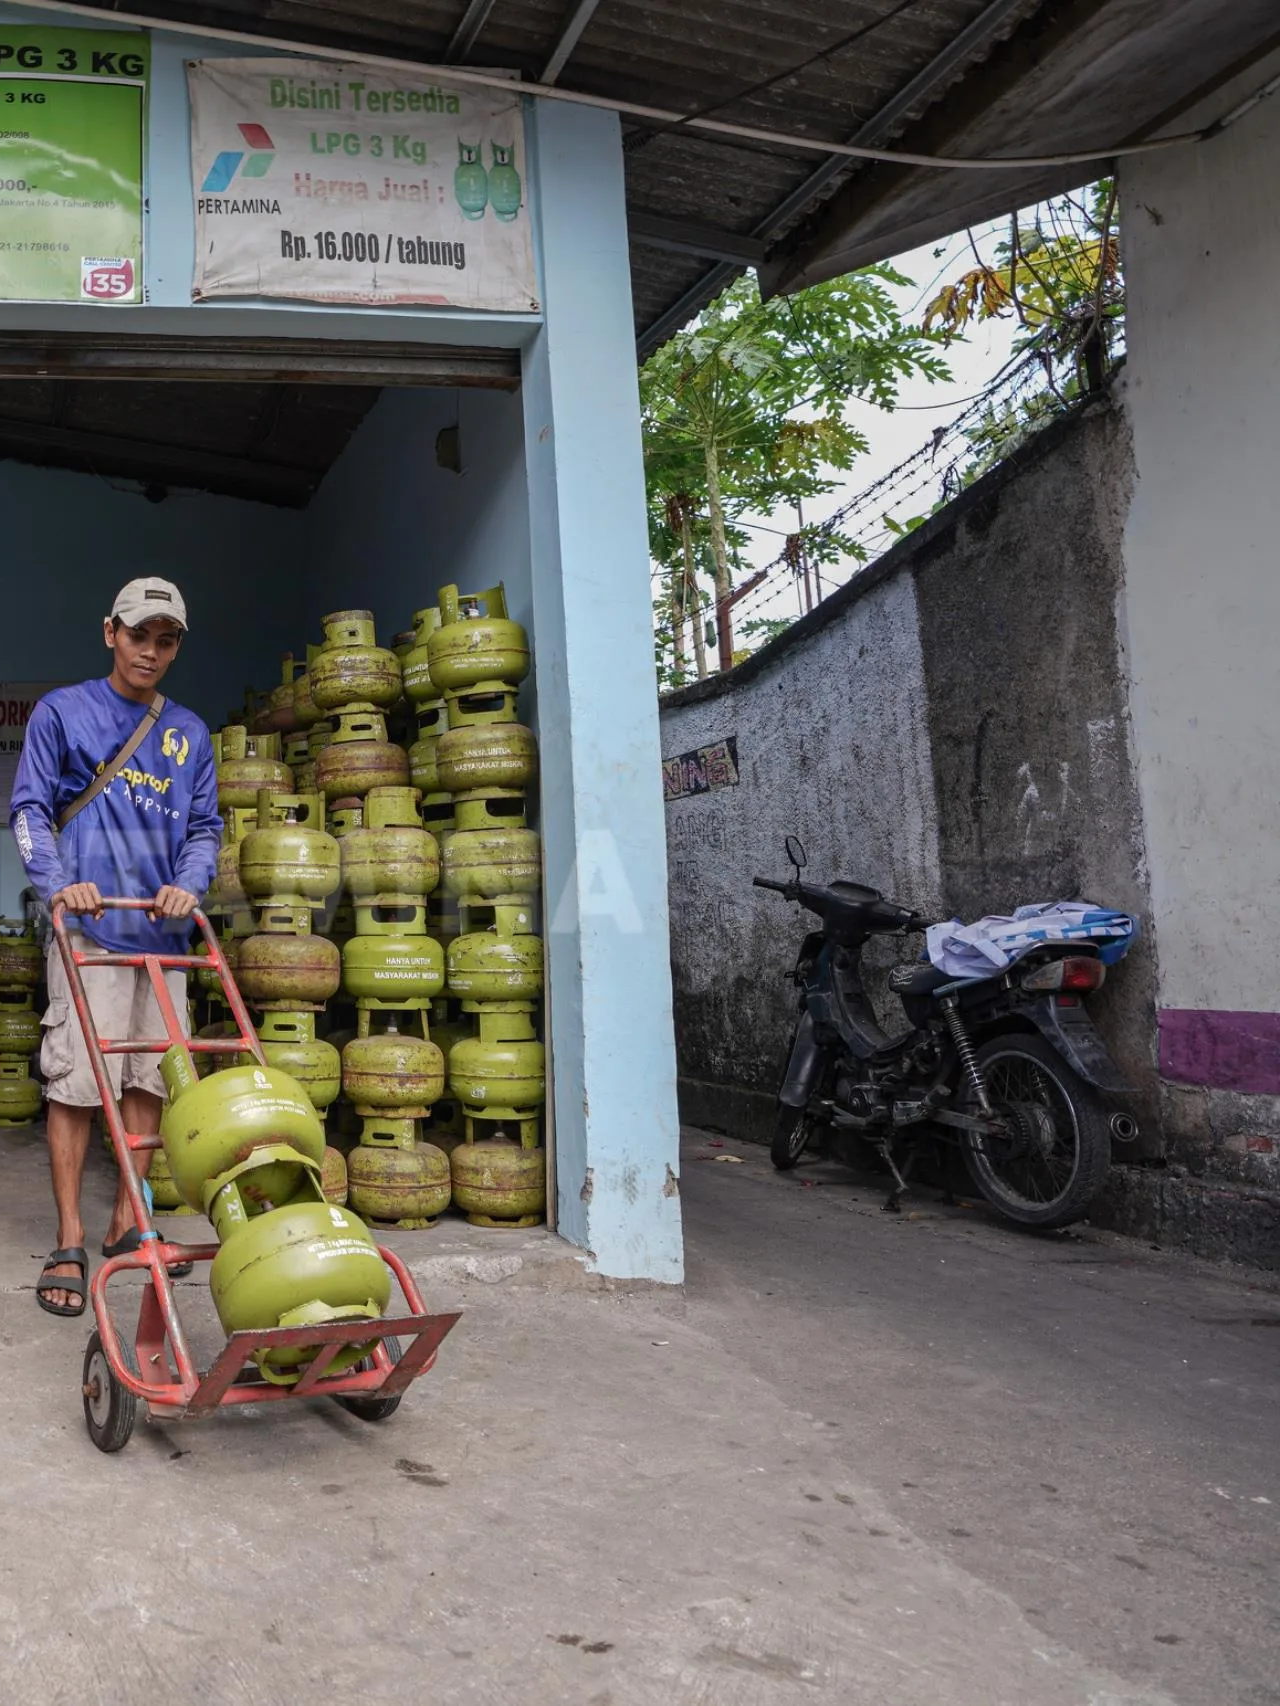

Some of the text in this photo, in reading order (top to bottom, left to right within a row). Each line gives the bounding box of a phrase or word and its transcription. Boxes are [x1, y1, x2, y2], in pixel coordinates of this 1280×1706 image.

[57, 48, 78, 71] 3
[91, 51, 146, 77] KG
[5, 93, 15, 103] 3
[20, 93, 46, 104] KG
[270, 78, 461, 115] Disini Tersedia
[310, 132, 428, 166] LPG 3 Kg
[294, 172, 369, 203] Harga
[378, 176, 430, 202] Jual
[62, 199, 91, 208] Tahun
[197, 198, 282, 215] PERTAMINA
[280, 230, 466, 271] Rp. 16.000 / tabung
[86, 273, 126, 294] 135
[386, 957, 410, 966] HANYA
[374, 972, 420, 980] MASYARAKAT
